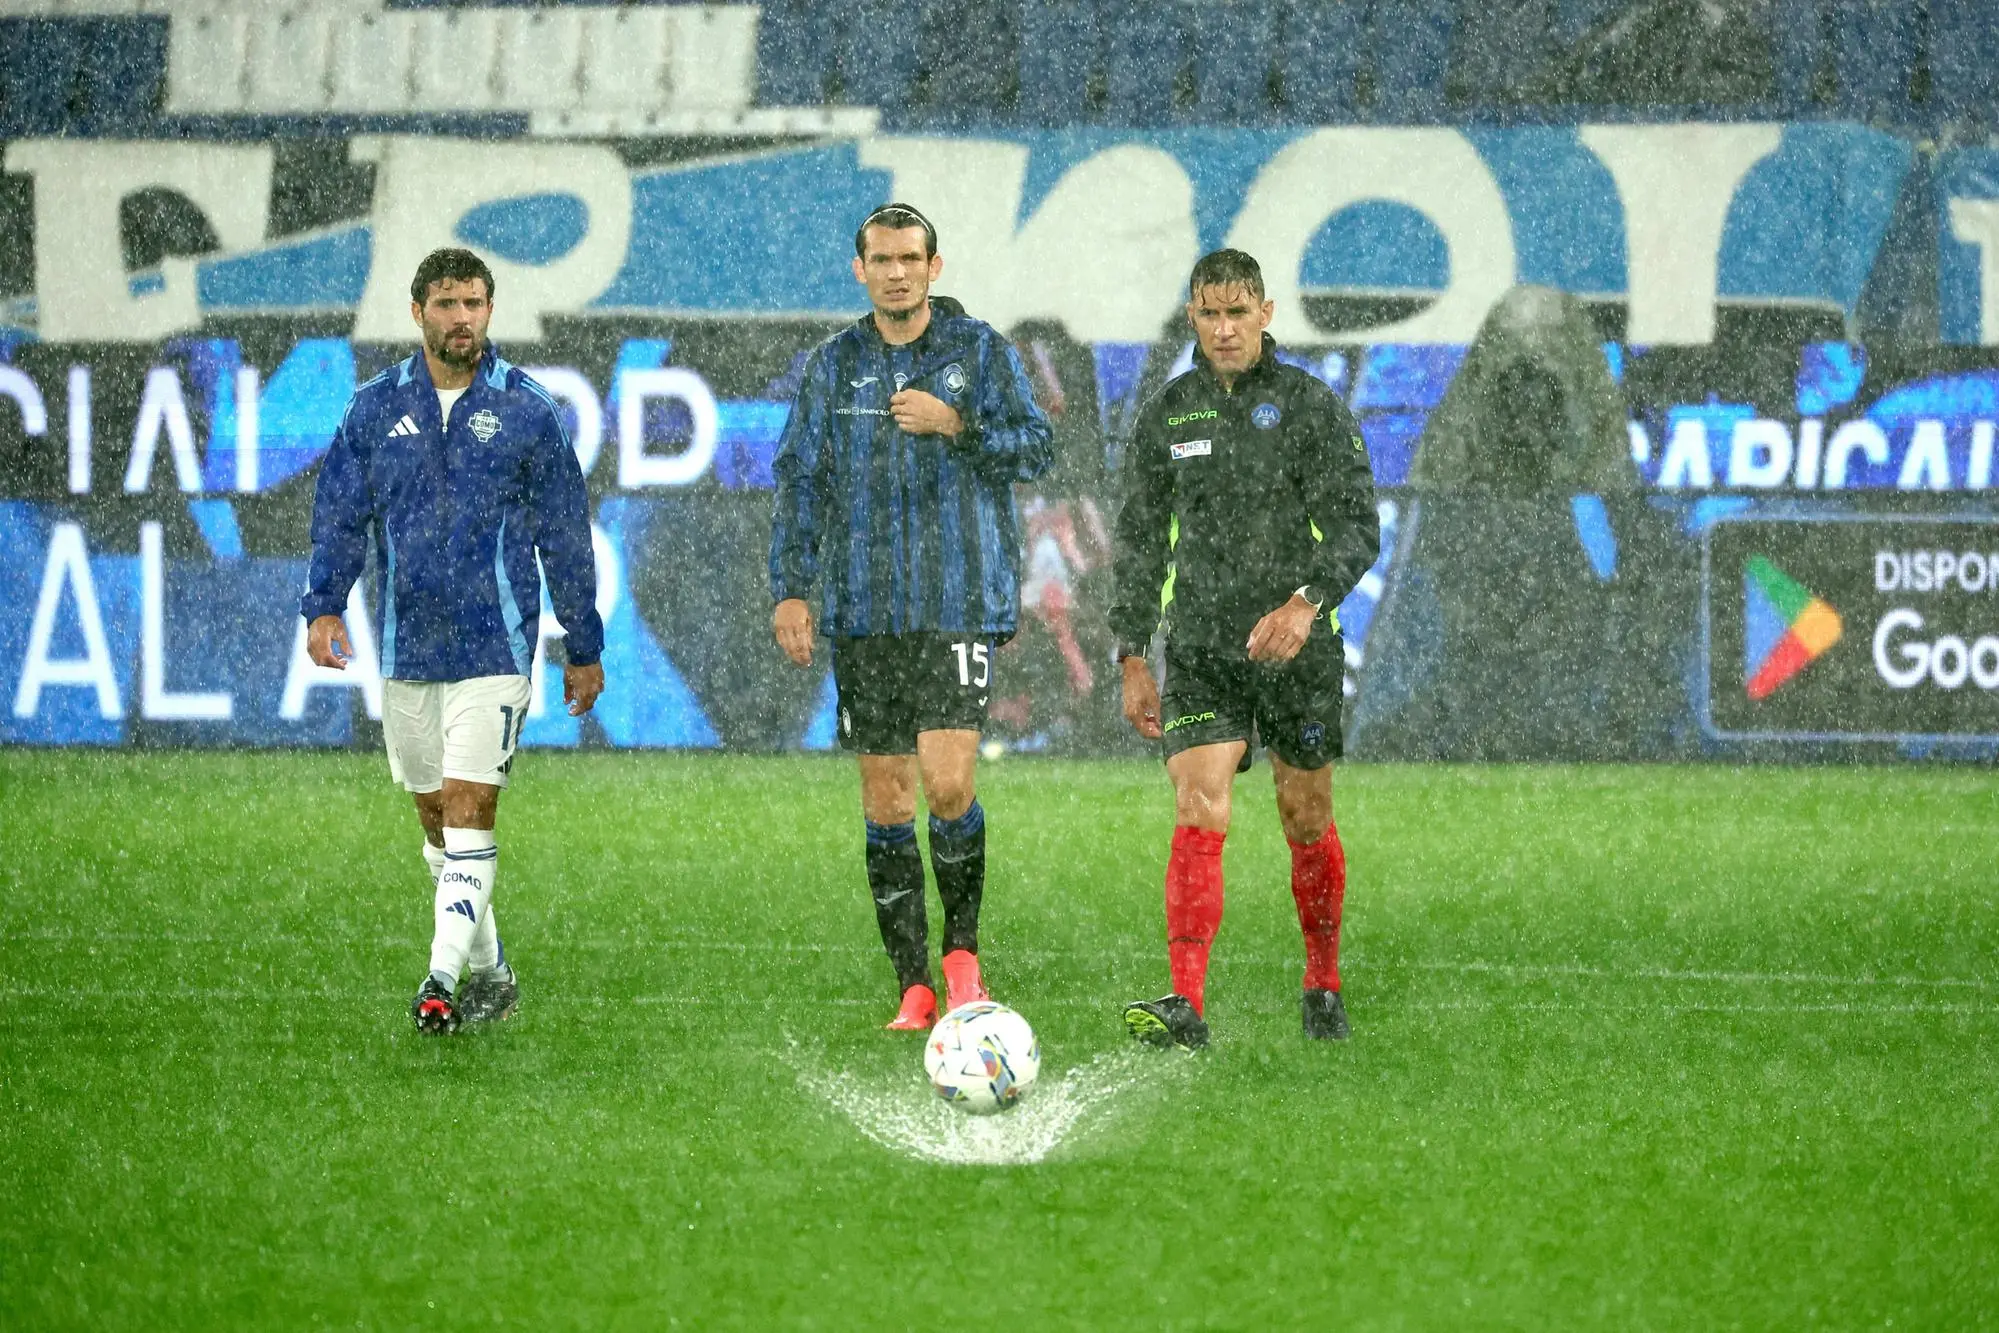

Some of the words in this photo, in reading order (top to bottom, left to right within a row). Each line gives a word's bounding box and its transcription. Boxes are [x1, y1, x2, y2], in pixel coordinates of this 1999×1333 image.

[476, 419, 495, 429] COMO
[1168, 410, 1218, 426] GIVOVA
[951, 642, 989, 688] 15
[443, 872, 482, 891] COMO
